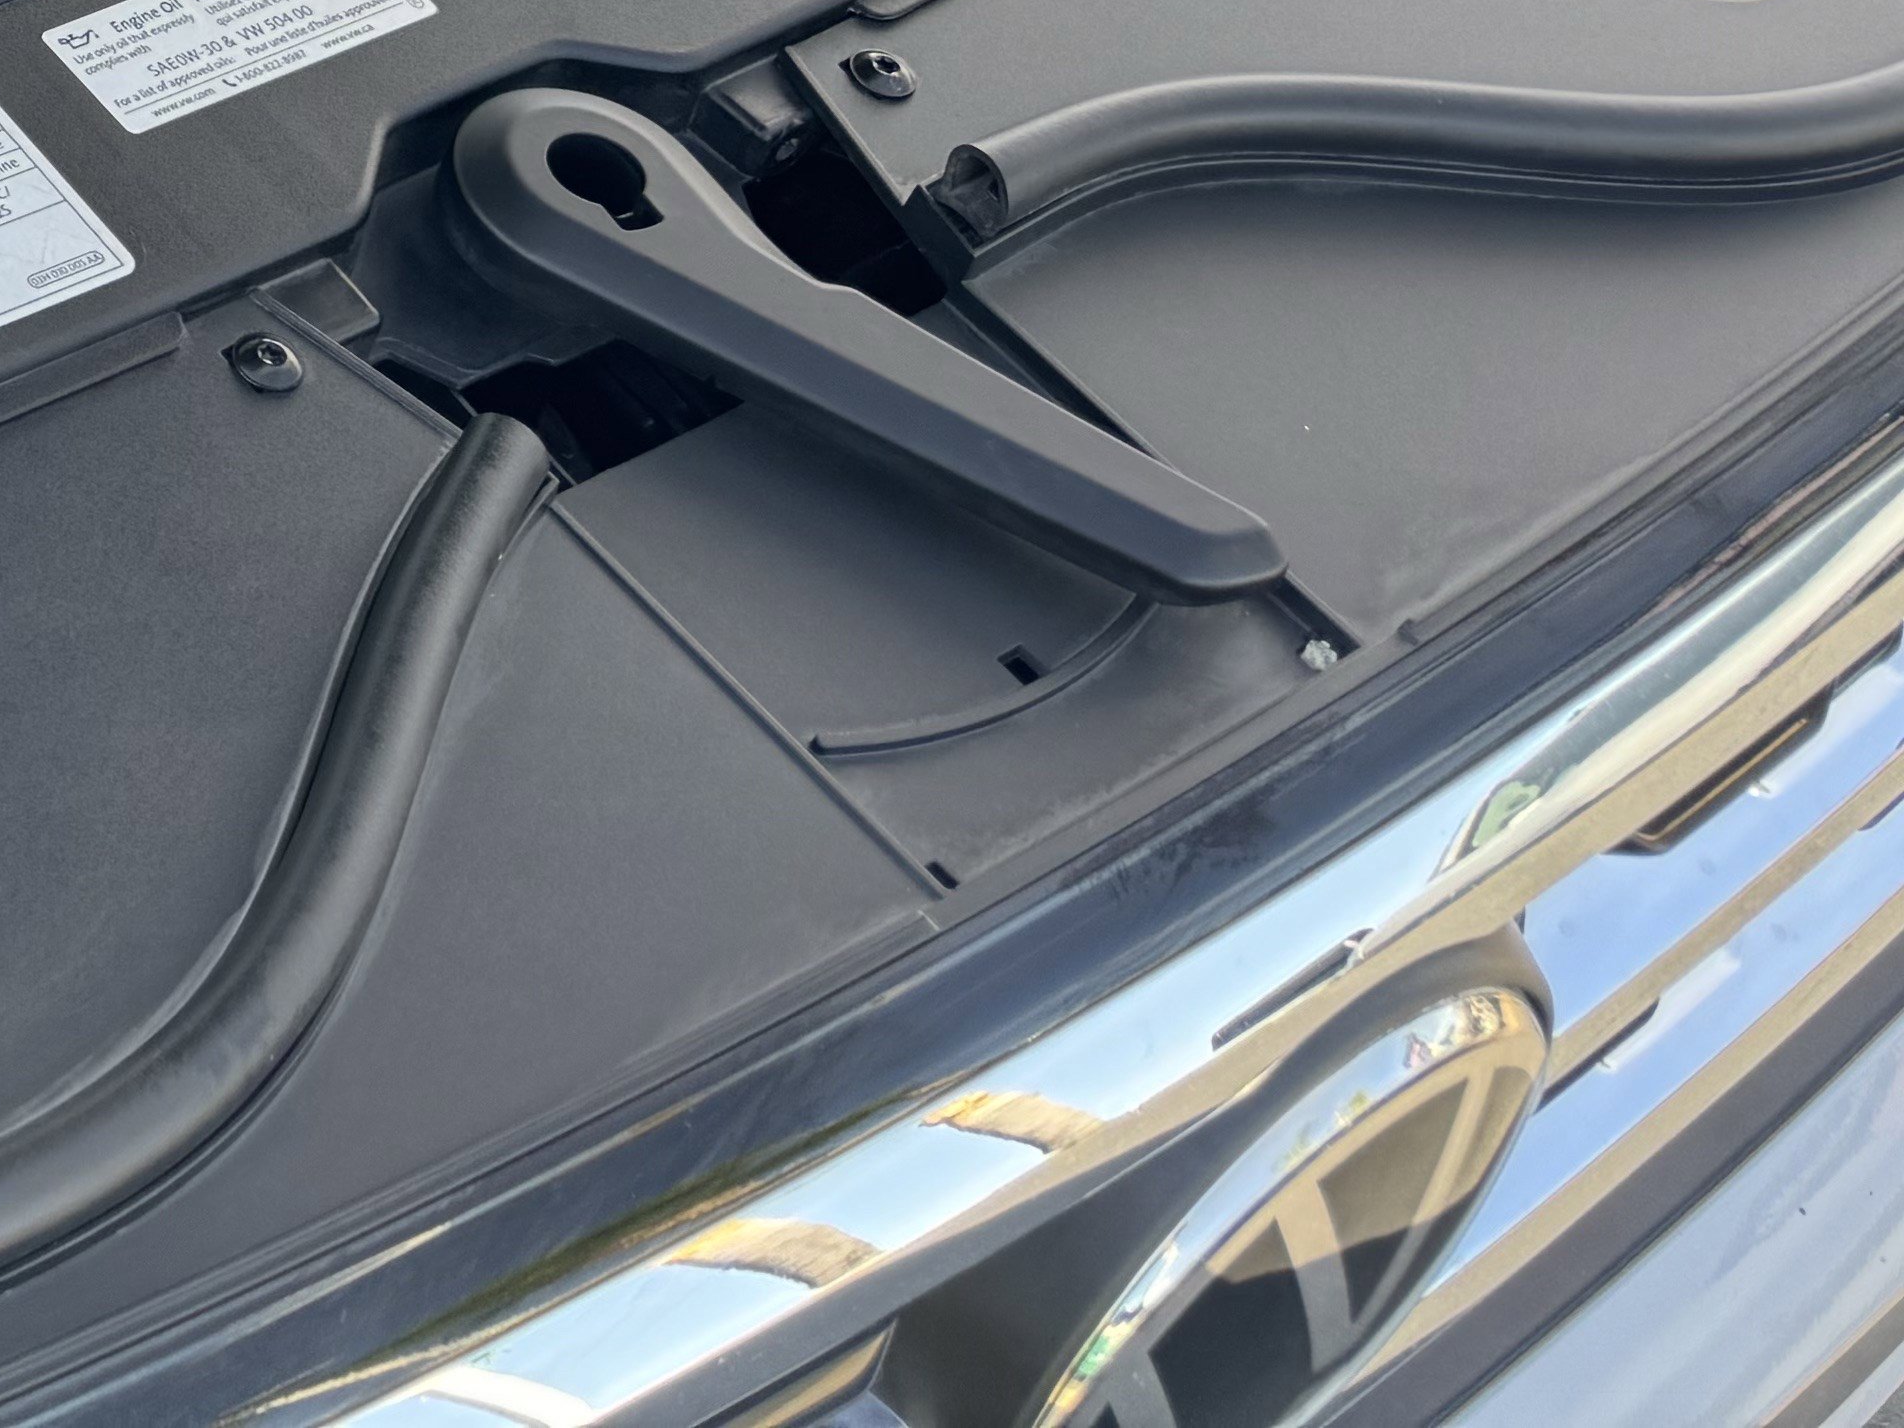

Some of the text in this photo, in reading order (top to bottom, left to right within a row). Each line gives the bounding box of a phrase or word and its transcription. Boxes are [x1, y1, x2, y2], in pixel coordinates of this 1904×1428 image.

[109, 8, 160, 32] Engine
[220, 35, 237, 48] &
[235, 22, 264, 40] VW
[263, 12, 293, 30] 504
[291, 4, 313, 19] 00
